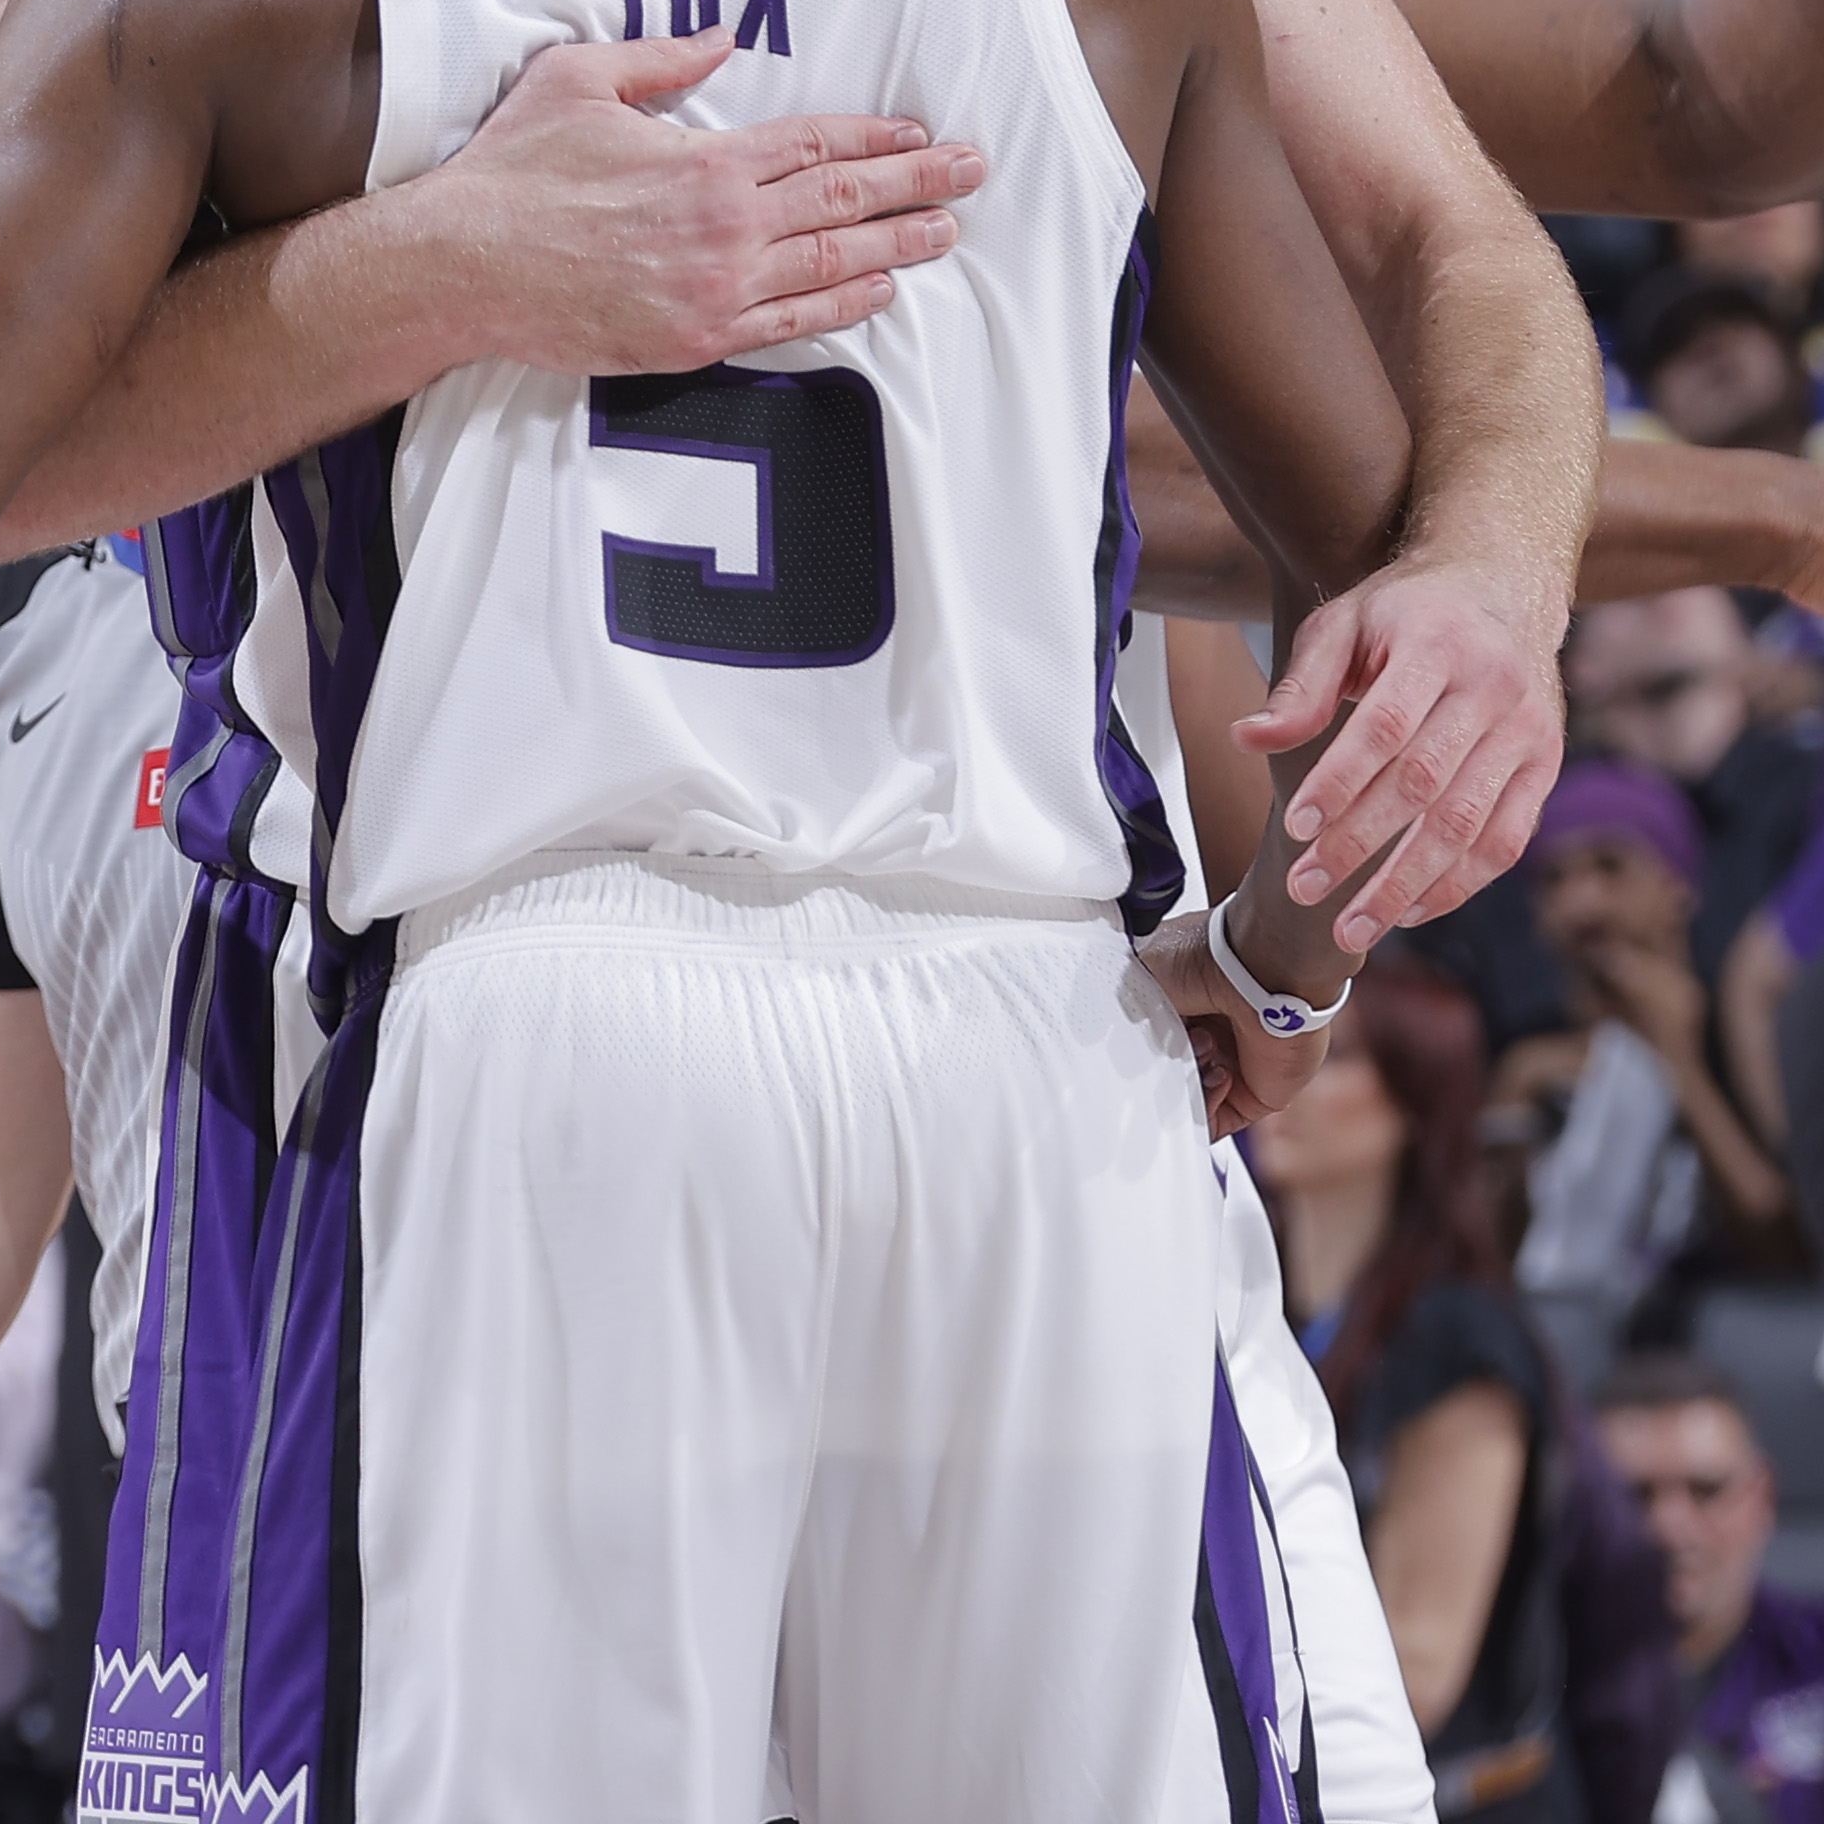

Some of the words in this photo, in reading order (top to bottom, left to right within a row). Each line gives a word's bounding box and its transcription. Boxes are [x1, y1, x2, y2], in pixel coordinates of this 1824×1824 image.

[590, 361, 896, 669] 5
[89, 1726, 205, 1754] SACRAMENTO
[80, 1758, 203, 1816] KINGS
